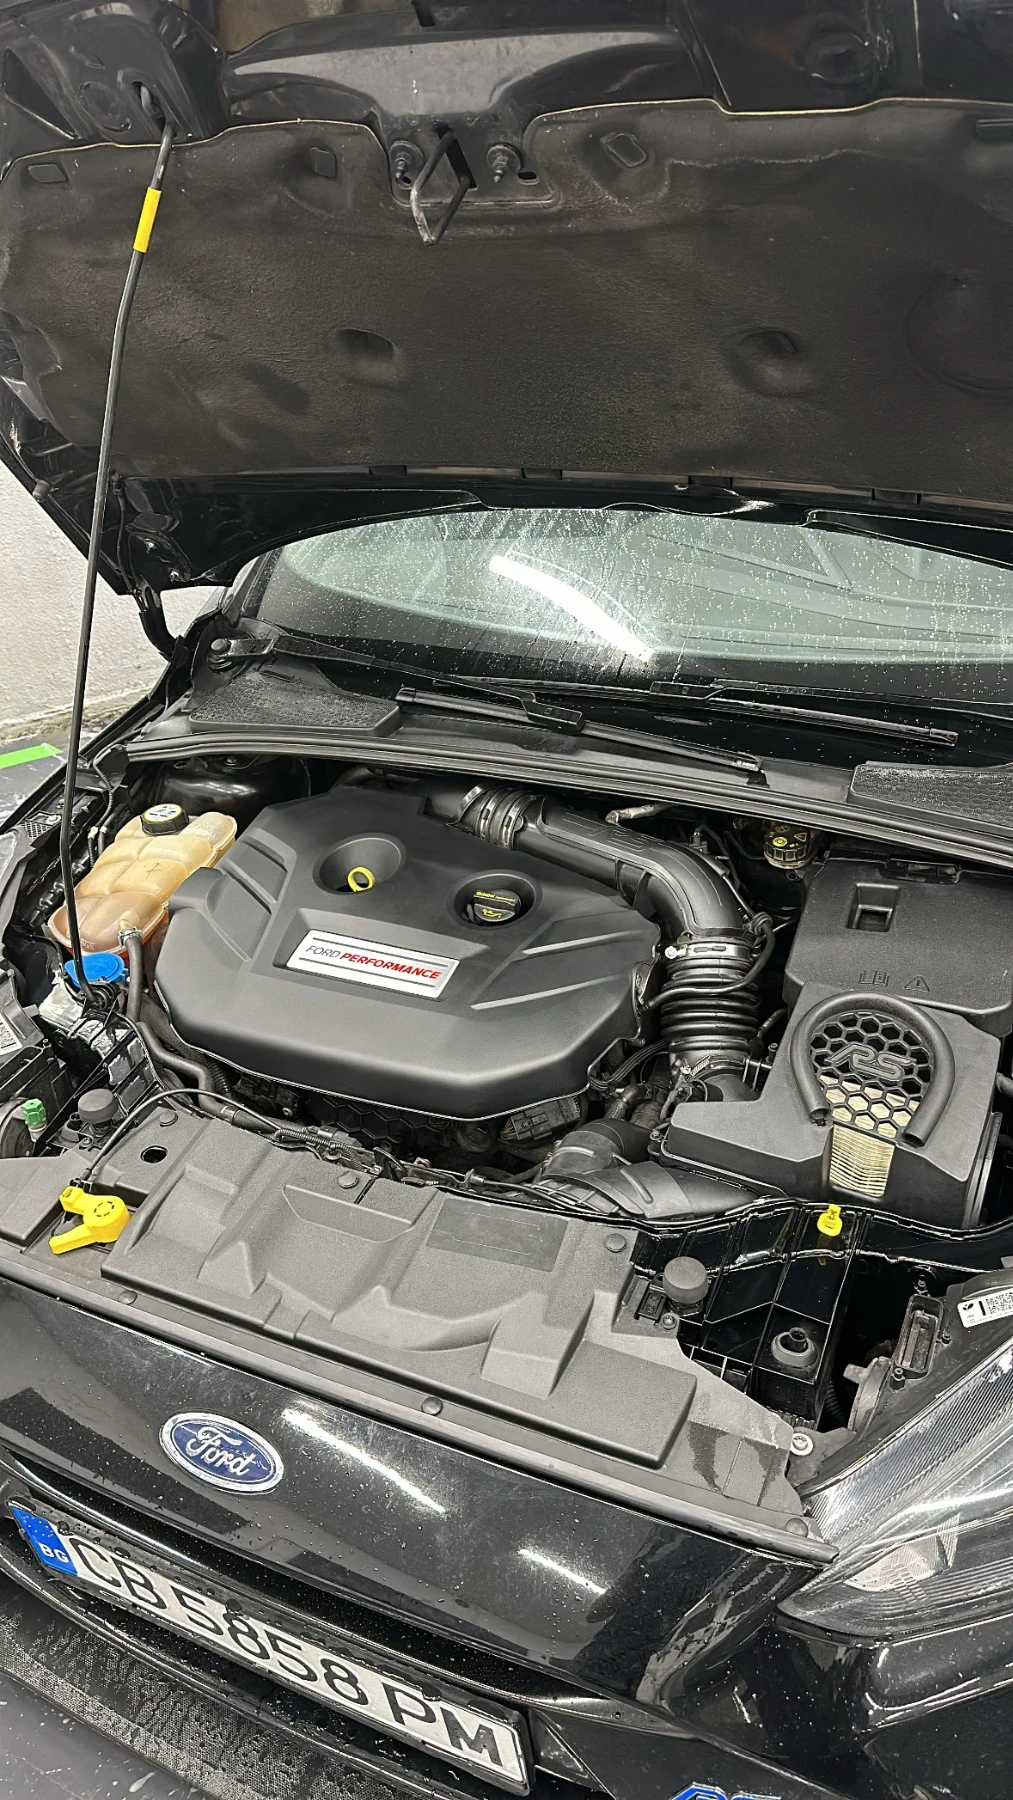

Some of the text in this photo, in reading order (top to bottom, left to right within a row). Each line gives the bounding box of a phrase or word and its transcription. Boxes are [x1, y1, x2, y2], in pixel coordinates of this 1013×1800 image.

[305, 945, 442, 980] FORD PERFORMANCE
[824, 1042, 917, 1081] RS
[184, 1426, 257, 1476] Ford
[38, 1542, 69, 1563] BG
[170, 1585, 369, 1706] 5858
[381, 1681, 504, 1768] PM
